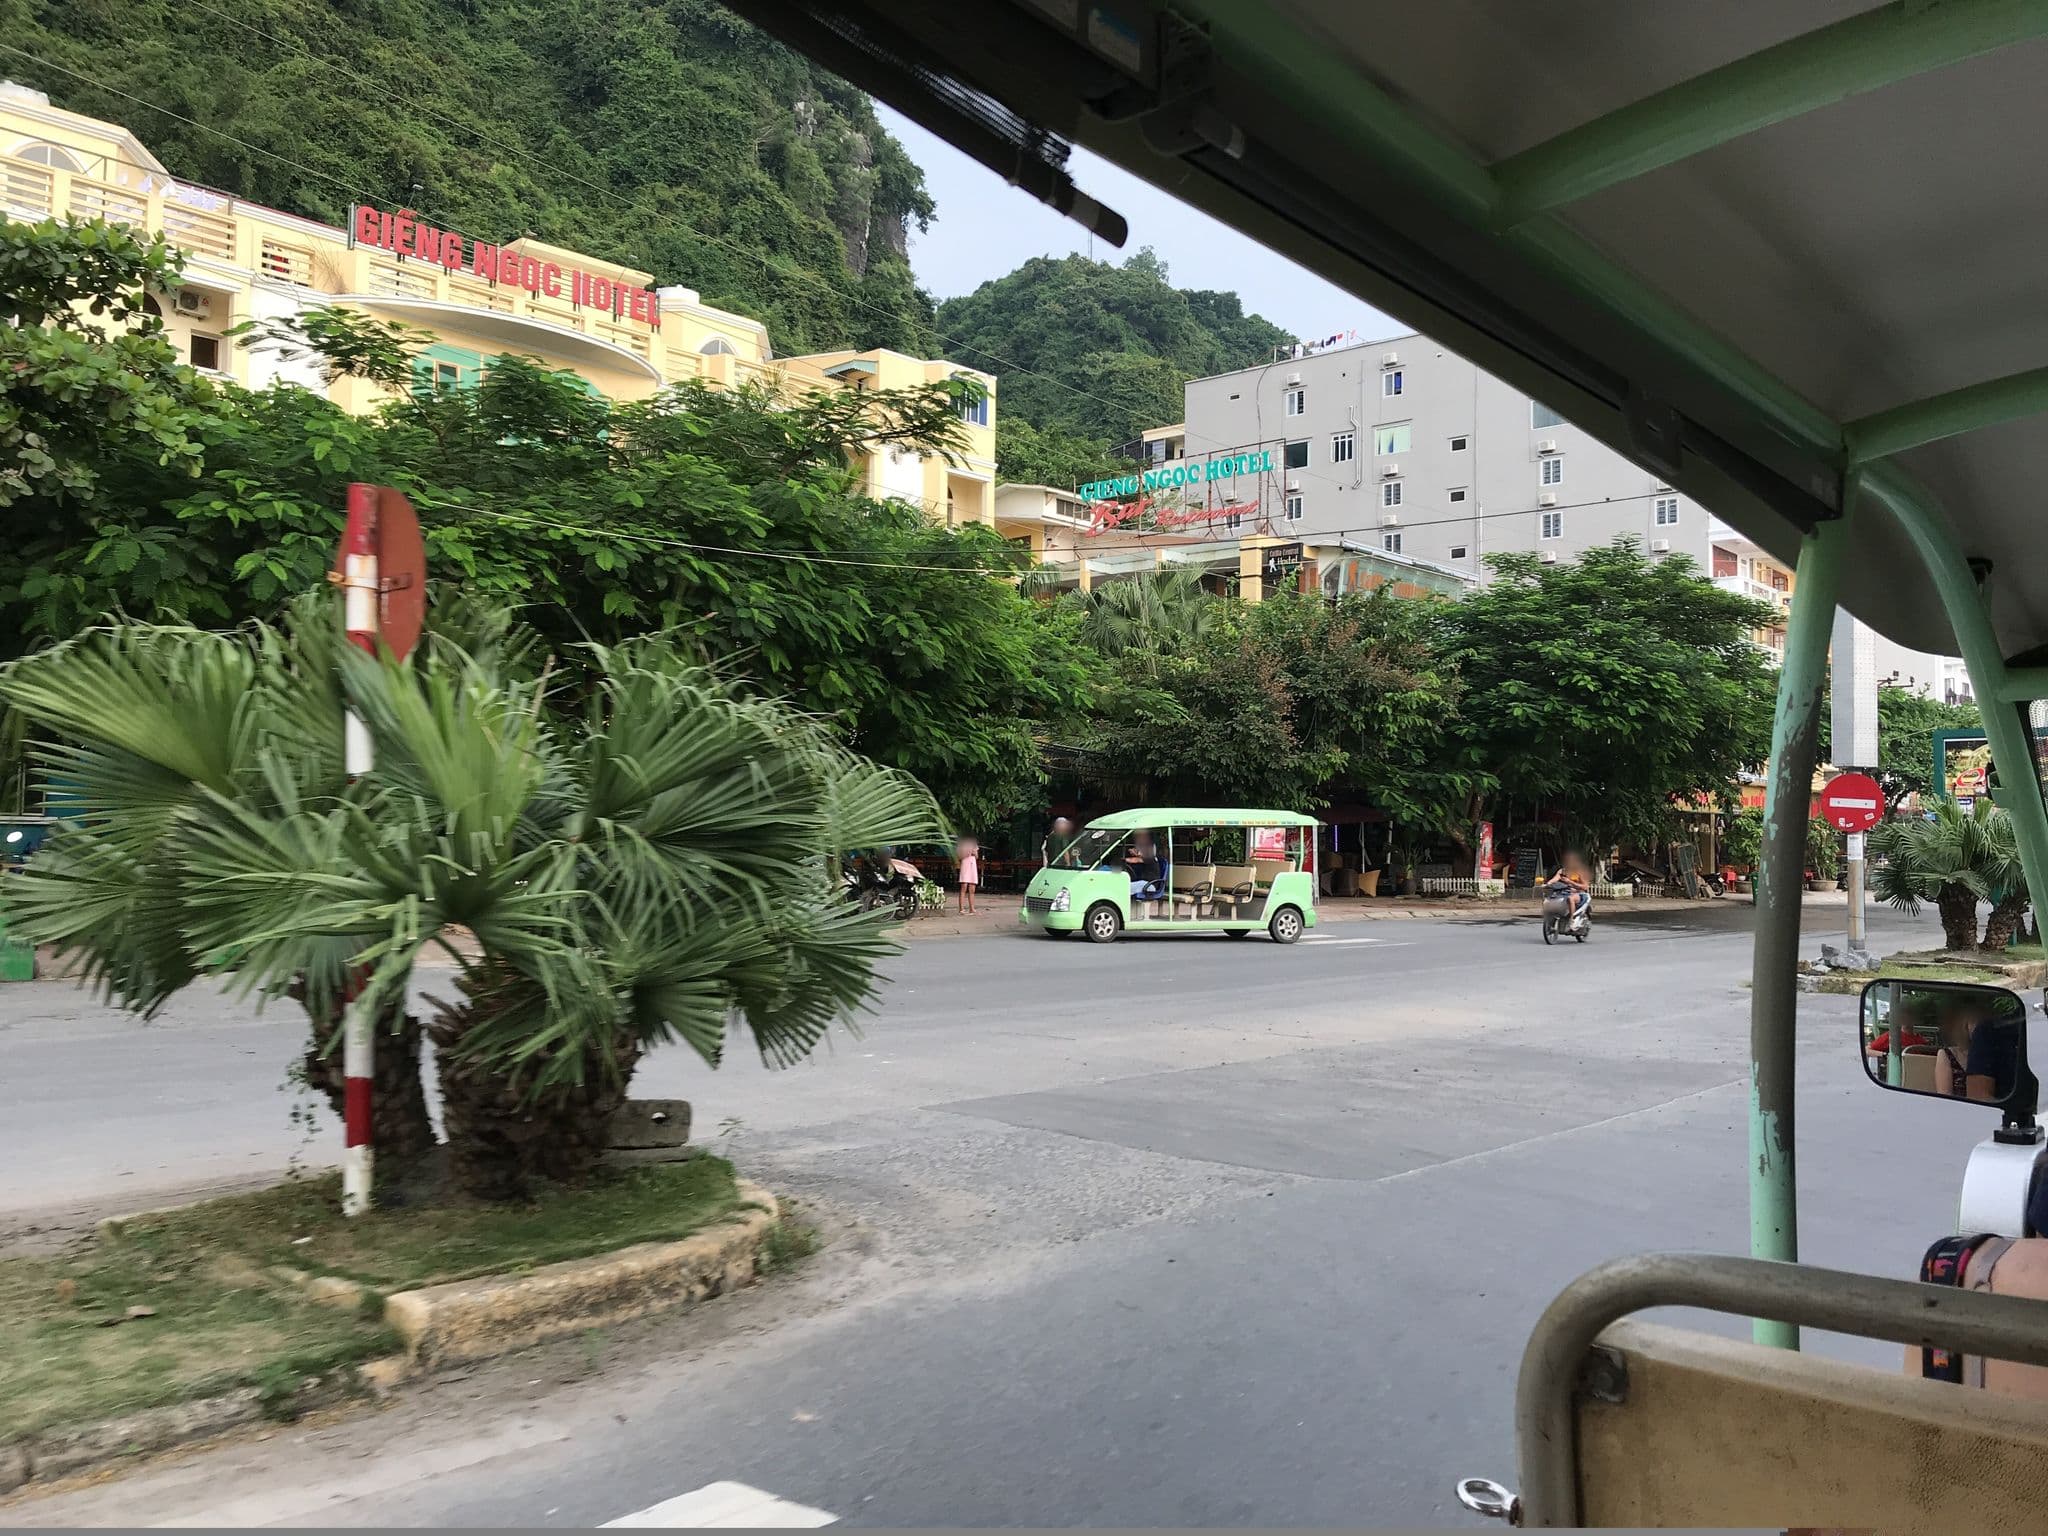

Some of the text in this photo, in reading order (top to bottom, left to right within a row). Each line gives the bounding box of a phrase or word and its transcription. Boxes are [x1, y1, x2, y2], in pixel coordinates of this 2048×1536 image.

[572, 270, 661, 326] HOTEL
[1205, 450, 1274, 481] HOTEL
[1085, 499, 1153, 538] Bar
